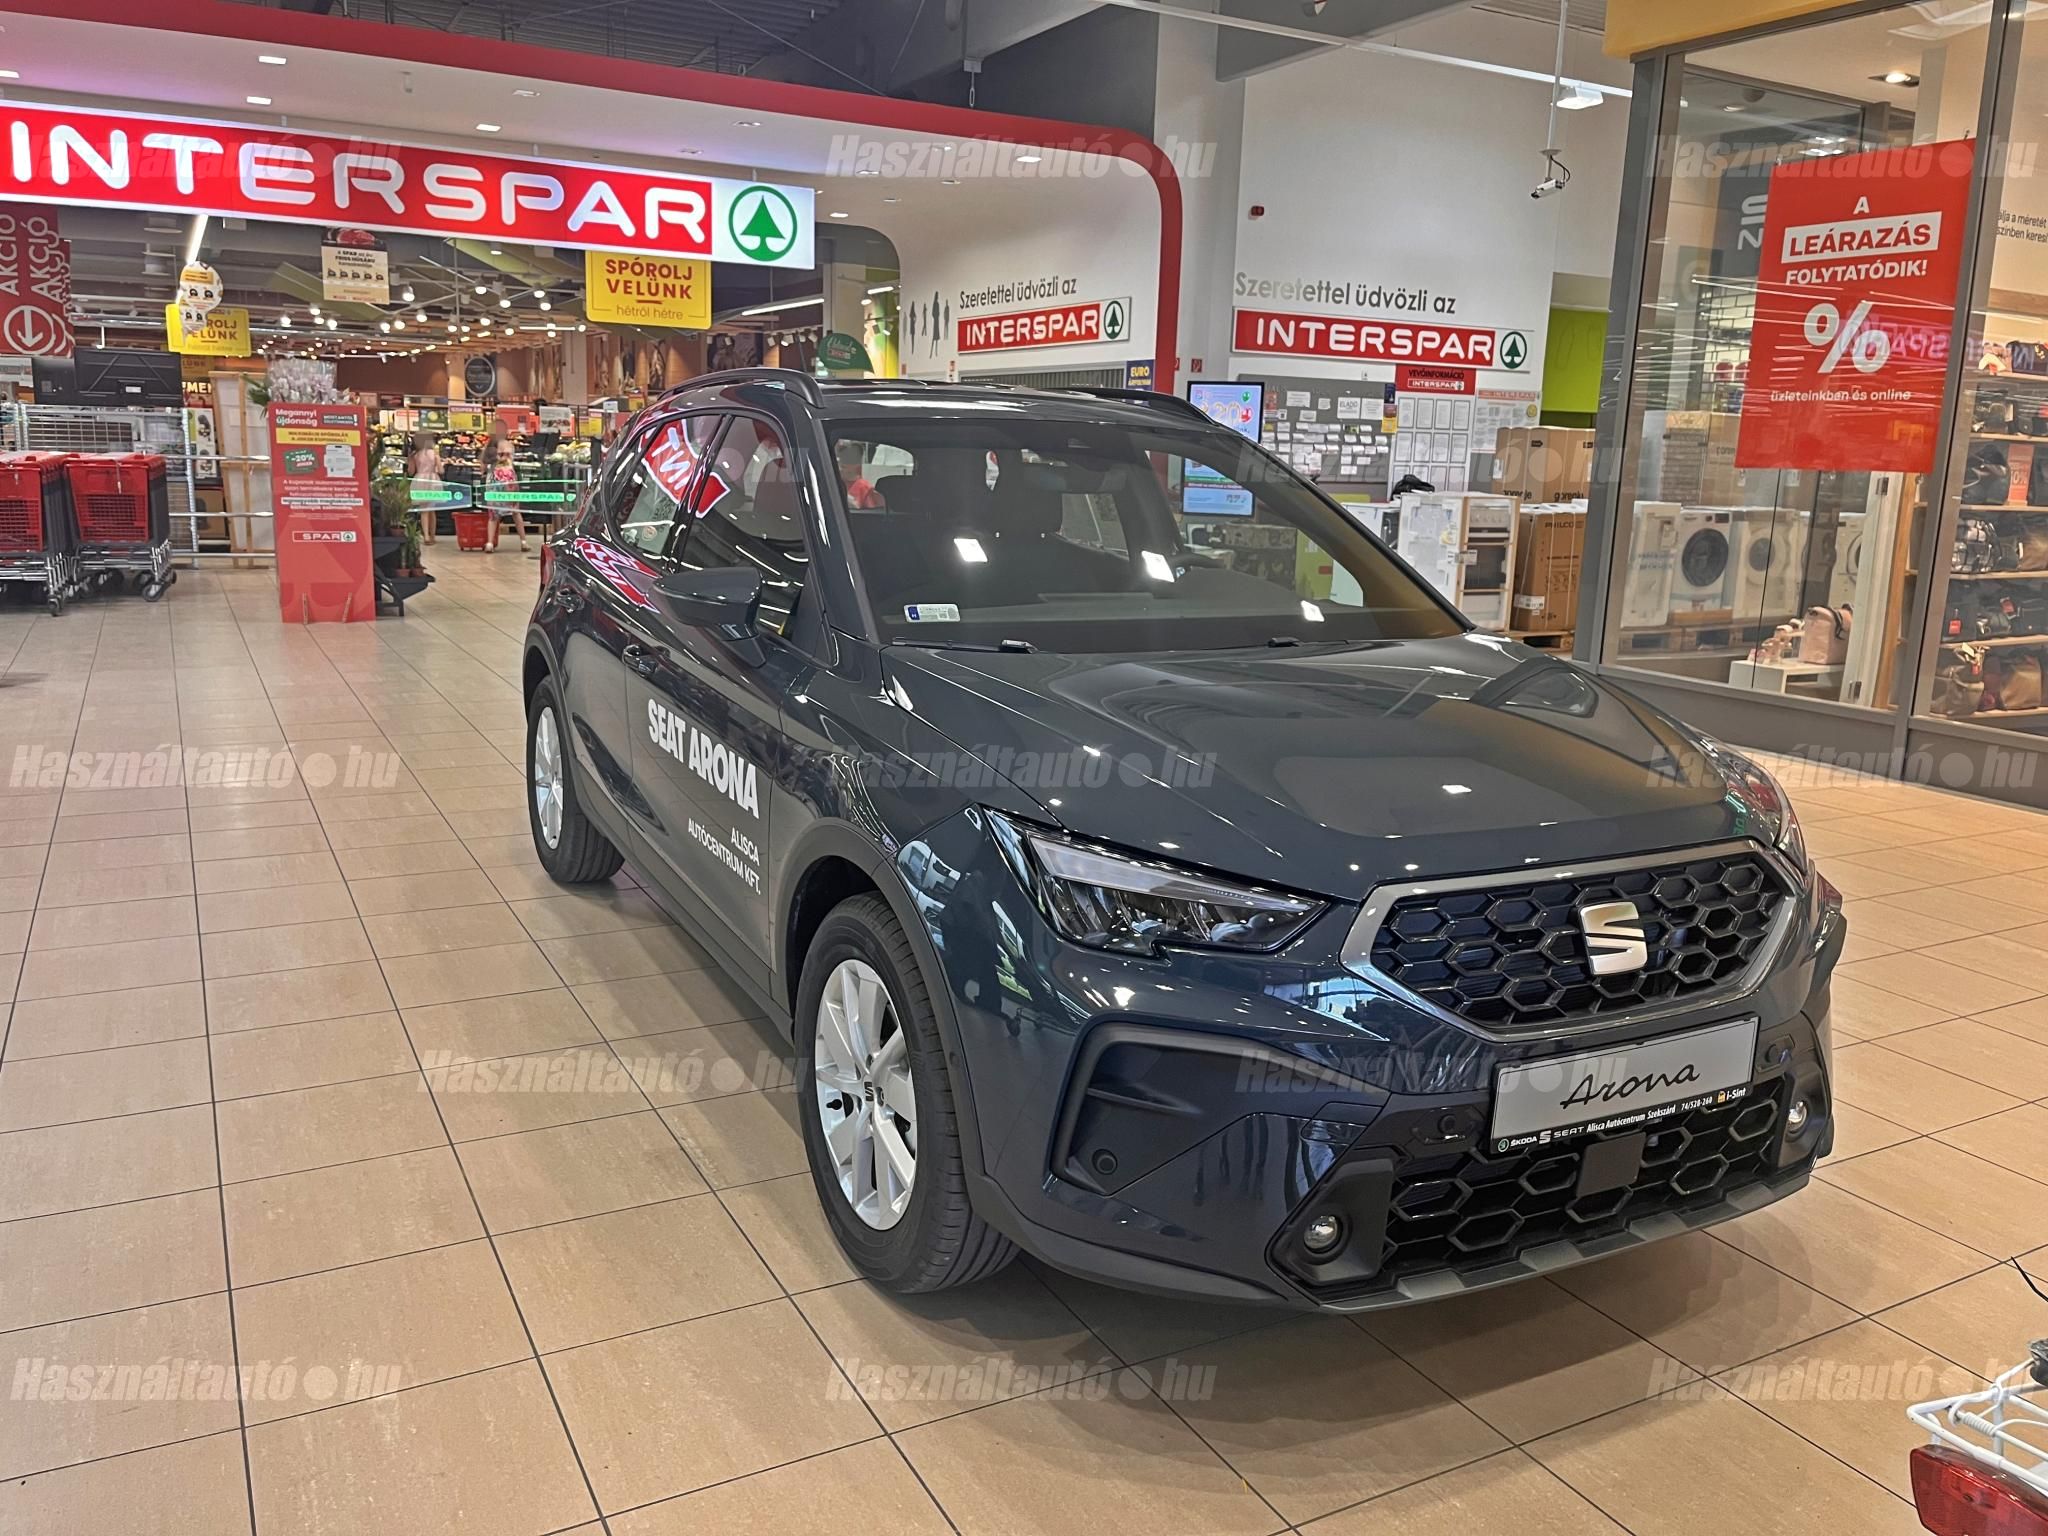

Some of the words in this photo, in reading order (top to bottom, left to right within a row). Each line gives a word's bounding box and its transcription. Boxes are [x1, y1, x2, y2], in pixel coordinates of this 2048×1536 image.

[10, 120, 706, 244] INTERSPAR
[1852, 196, 1870, 214] A
[20, 216, 51, 299] AKCIÓ
[1789, 220, 1931, 257] LEÁRAZÁS
[605, 256, 693, 281] SPÓROLJ
[1786, 259, 1927, 285] FOLYTATÓDIK!
[606, 277, 692, 300] VELÜNK
[959, 281, 1016, 310] Szeretettel
[1016, 277, 1059, 303] üdvözli
[1061, 276, 1077, 296] az
[1235, 271, 1350, 306] Szeretettel
[1355, 283, 1427, 312] üdvözli
[1433, 295, 1456, 314] az
[653, 306, 684, 321] hétre
[966, 309, 1098, 348] INTERSPAR
[191, 327, 238, 341] ELÜNK
[1256, 317, 1492, 361] INTERSPAR
[1412, 379, 1457, 390] INTERSPAR
[1770, 388, 1851, 402] üzleteinkben
[1870, 388, 1911, 401] online
[648, 698, 686, 763] SEAT
[689, 727, 760, 820] ARONA
[688, 817, 744, 881] AUTÓCENTRUM
[731, 827, 760, 866] ALISCA
[1559, 1063, 1701, 1110] Arona
[1510, 1136, 1538, 1147] ŠKODA
[1553, 1126, 1585, 1139] SEAT
[1586, 1121, 1605, 1133] Alisca
[1606, 1113, 1646, 1129] Autócentrum
[1647, 1104, 1677, 1120] Szekszárd
[1726, 1087, 1747, 1101] i-Sint
